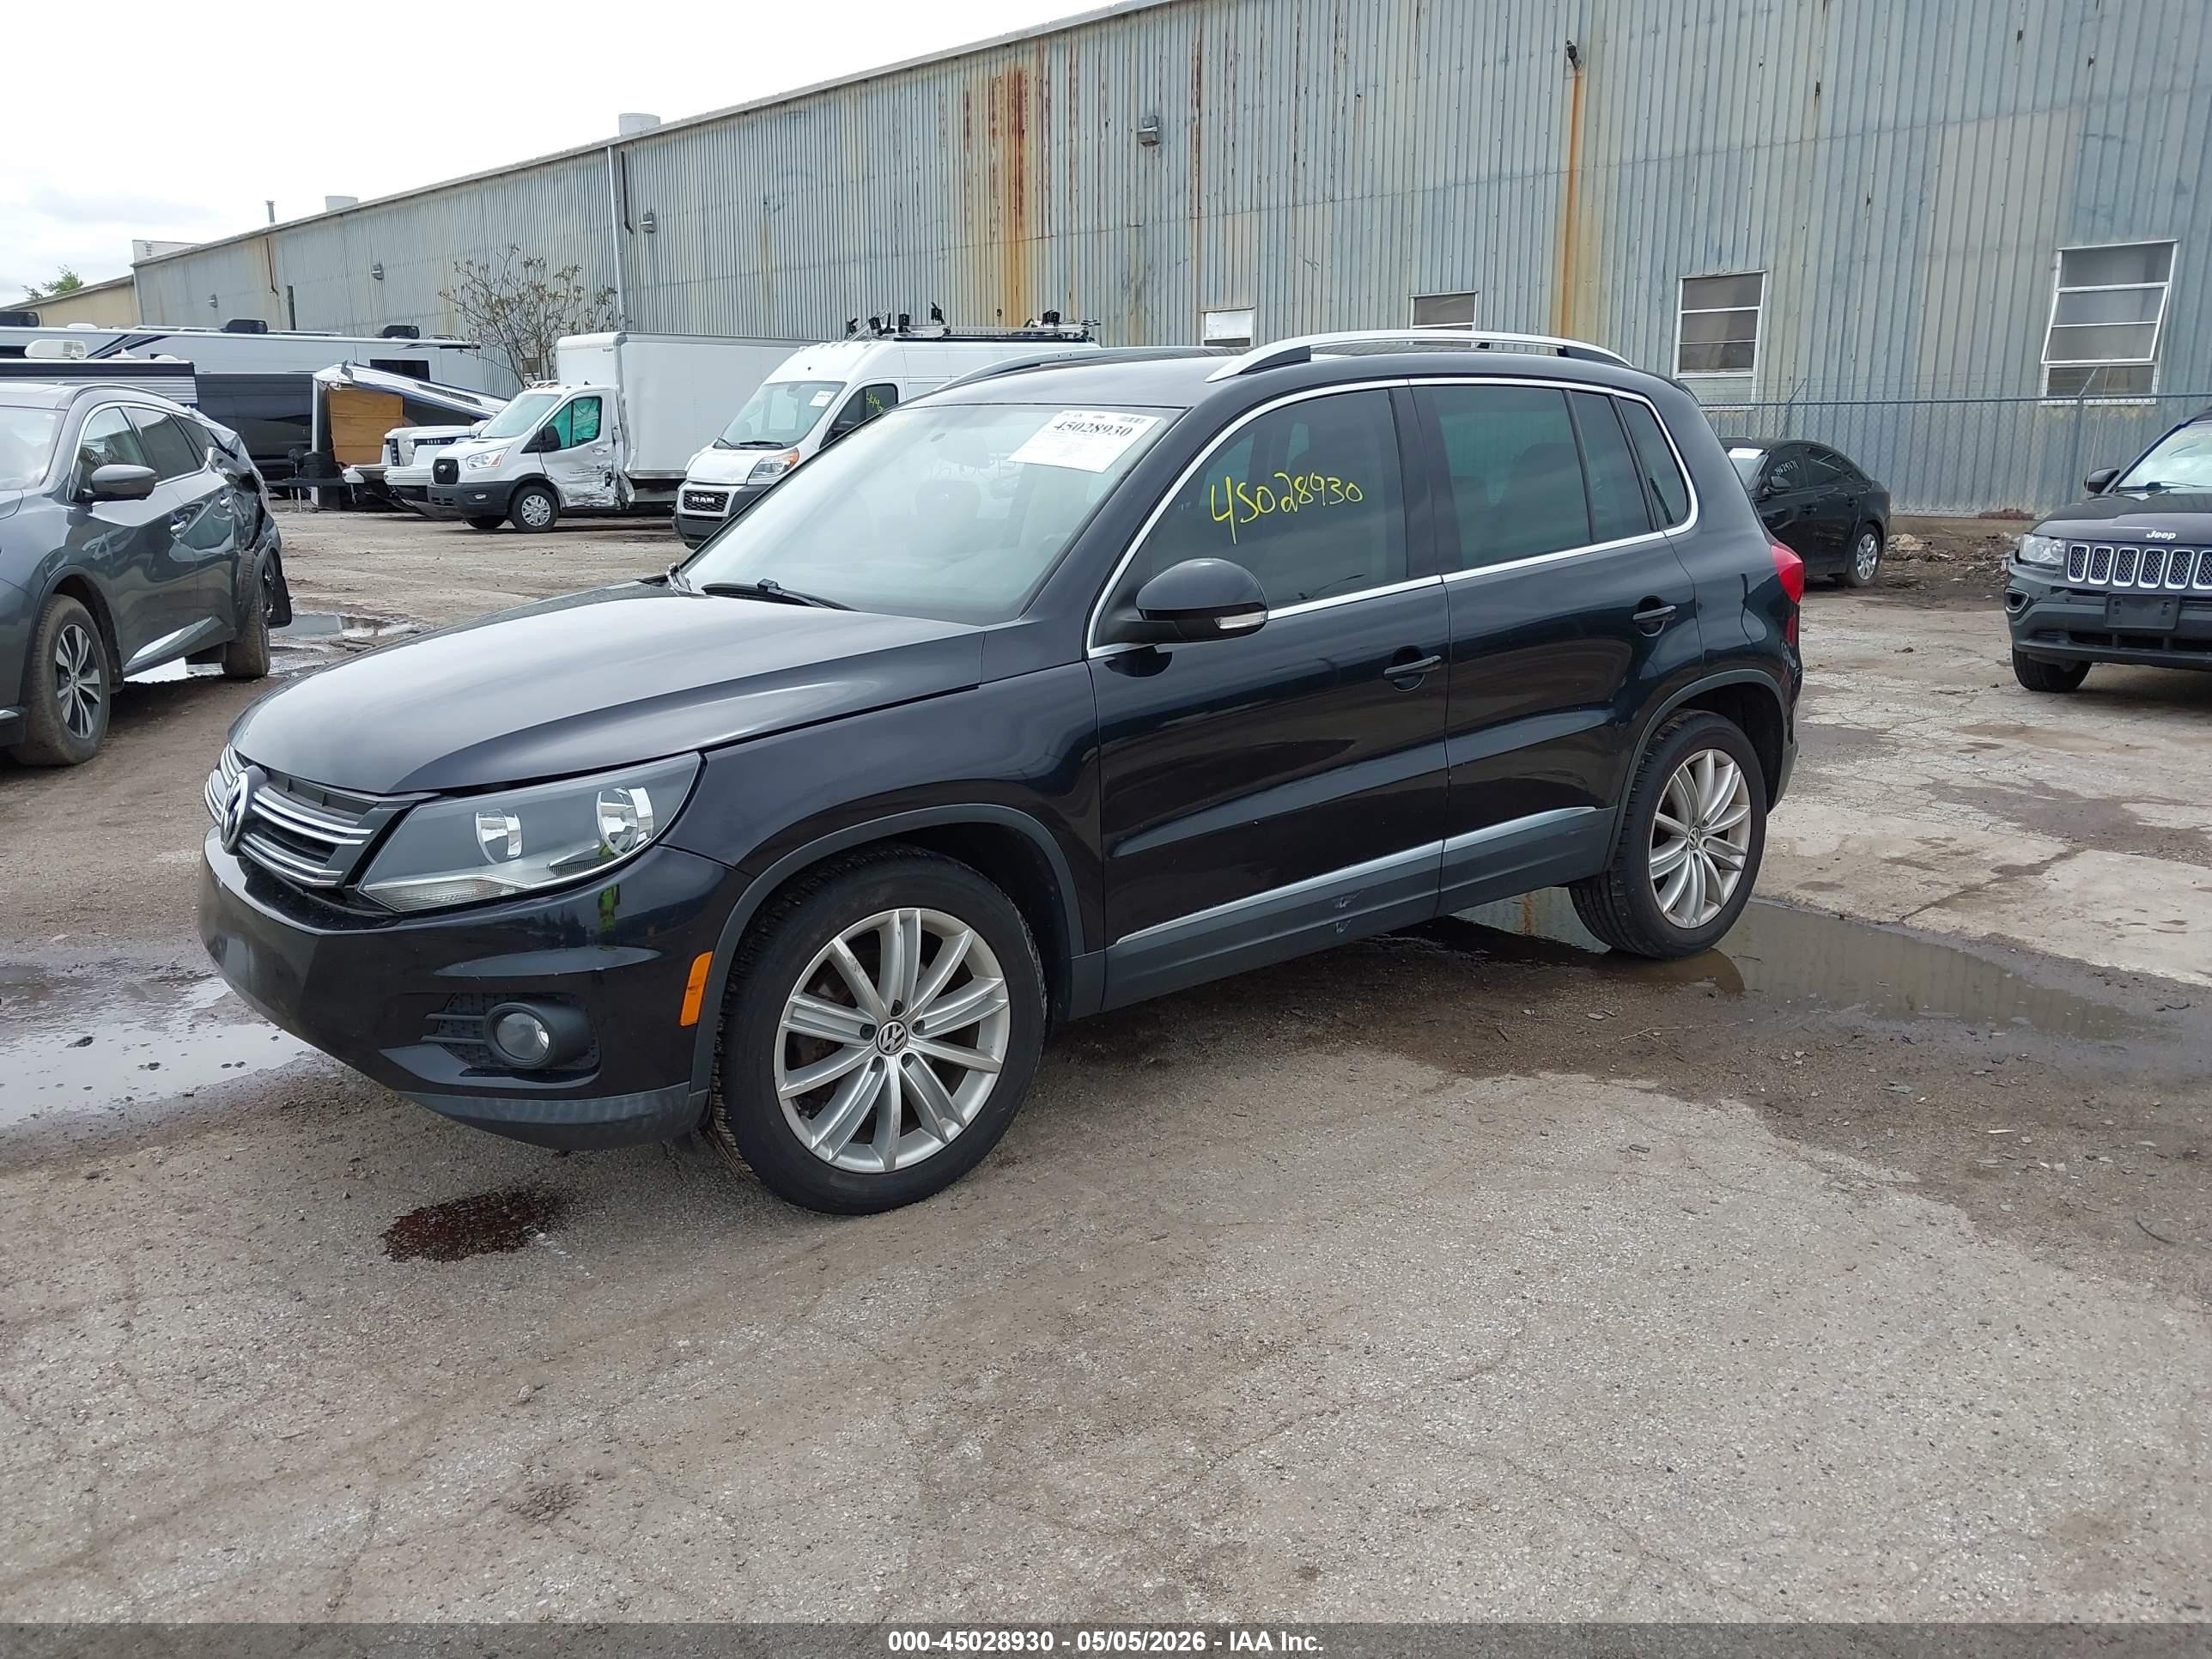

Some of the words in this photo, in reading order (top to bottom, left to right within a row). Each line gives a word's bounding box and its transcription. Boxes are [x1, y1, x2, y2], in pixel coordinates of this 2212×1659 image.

[1054, 421, 1133, 437] 45028930
[1211, 472, 1364, 544] 45028930
[2146, 530, 2177, 541] Jeep
